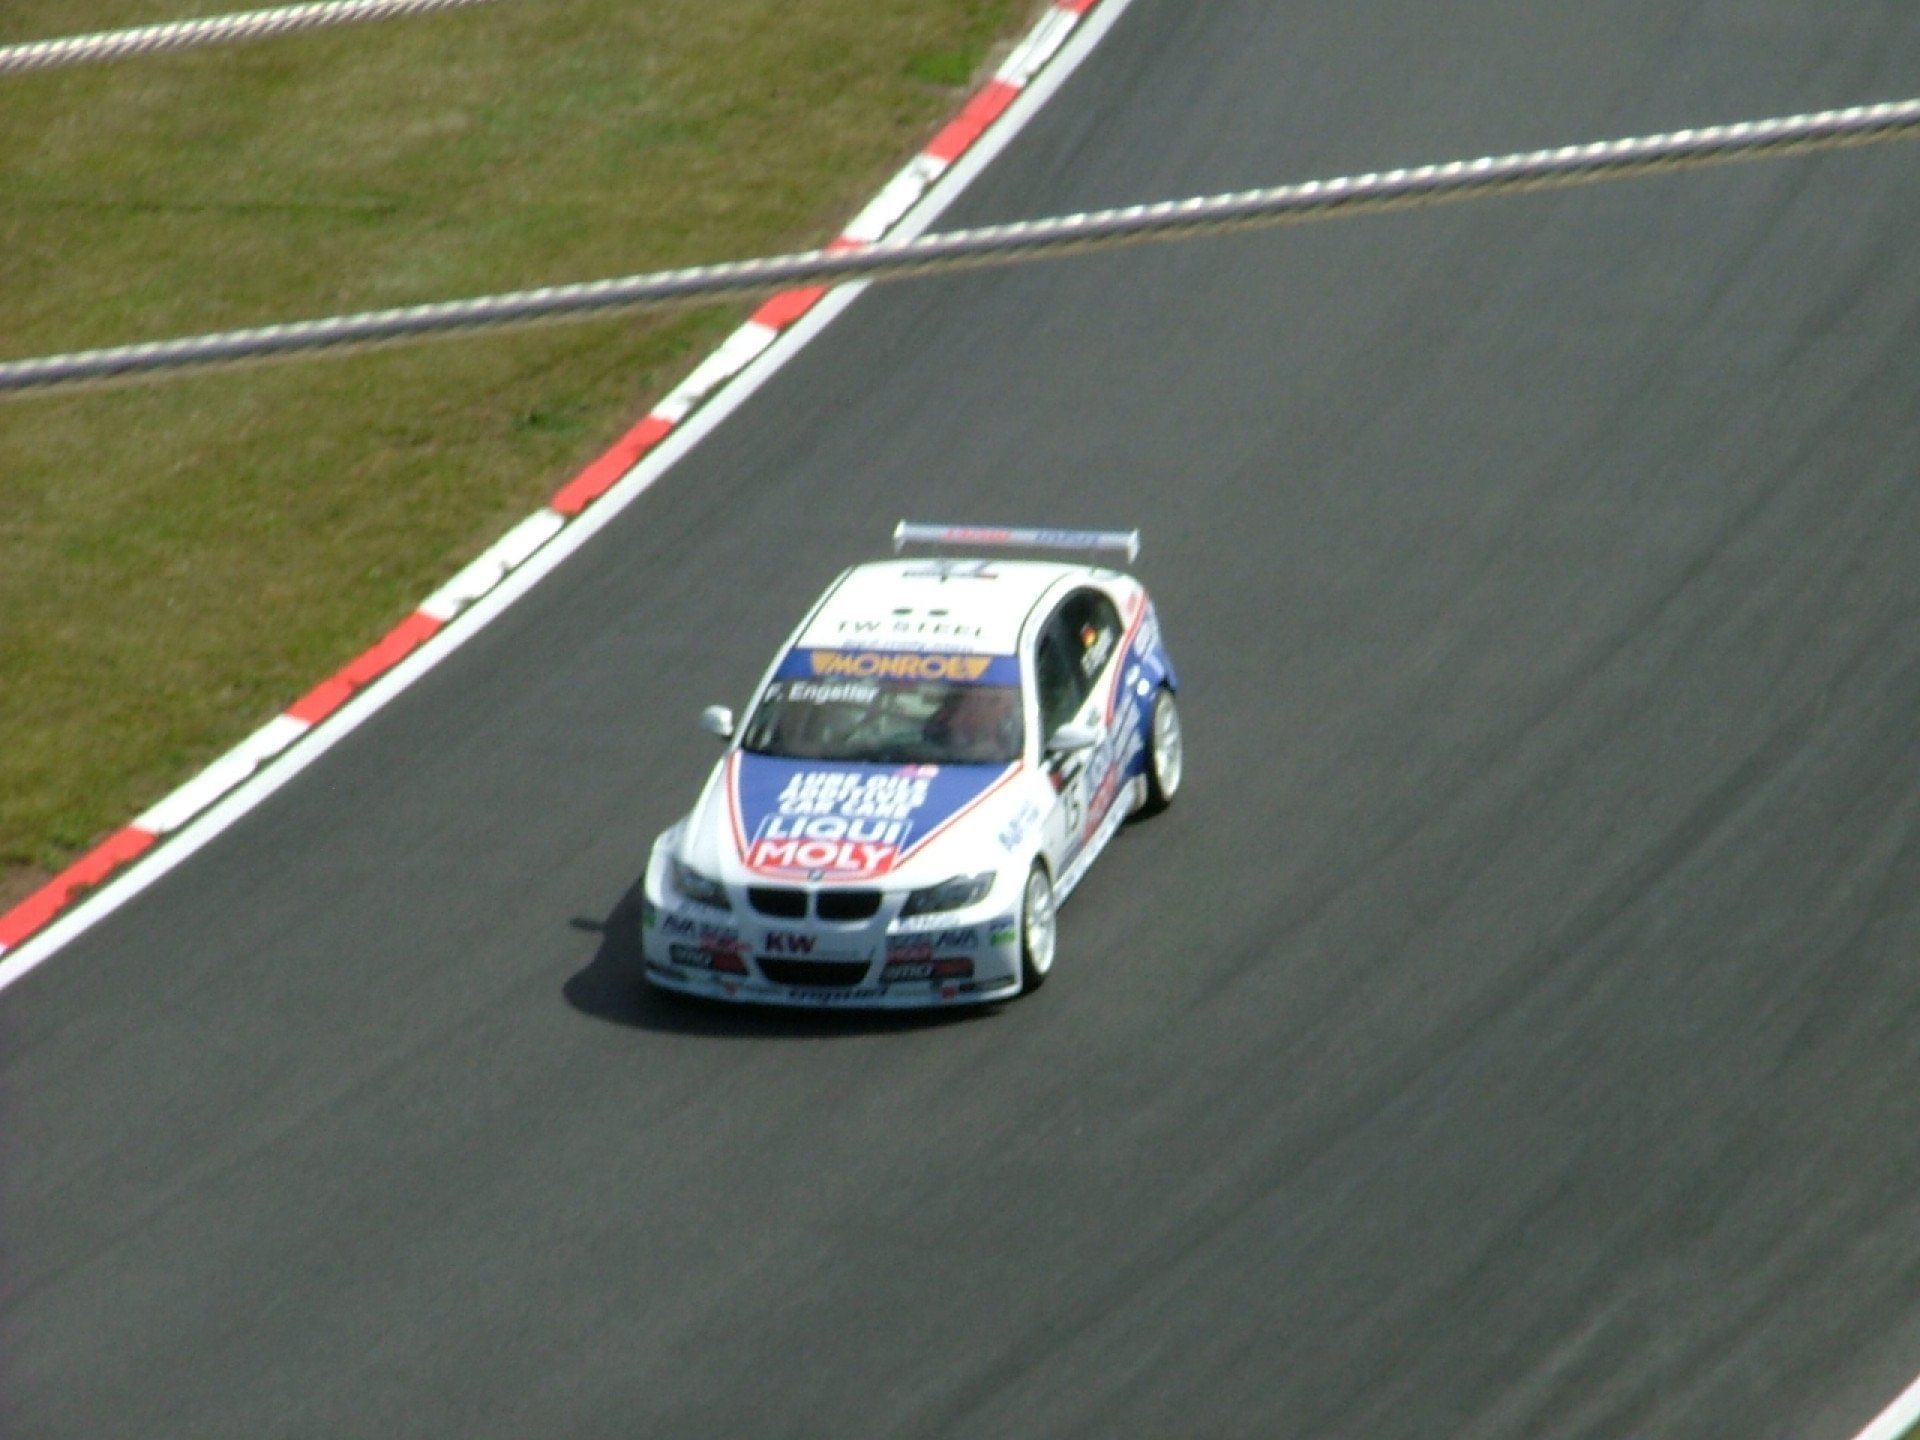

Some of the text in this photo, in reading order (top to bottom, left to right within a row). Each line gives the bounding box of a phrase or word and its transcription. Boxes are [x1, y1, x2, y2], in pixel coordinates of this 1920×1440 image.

[819, 652, 967, 681] MONROE
[764, 815, 901, 847] LIQUI
[752, 841, 897, 872] MOLY
[765, 931, 817, 954] KW
